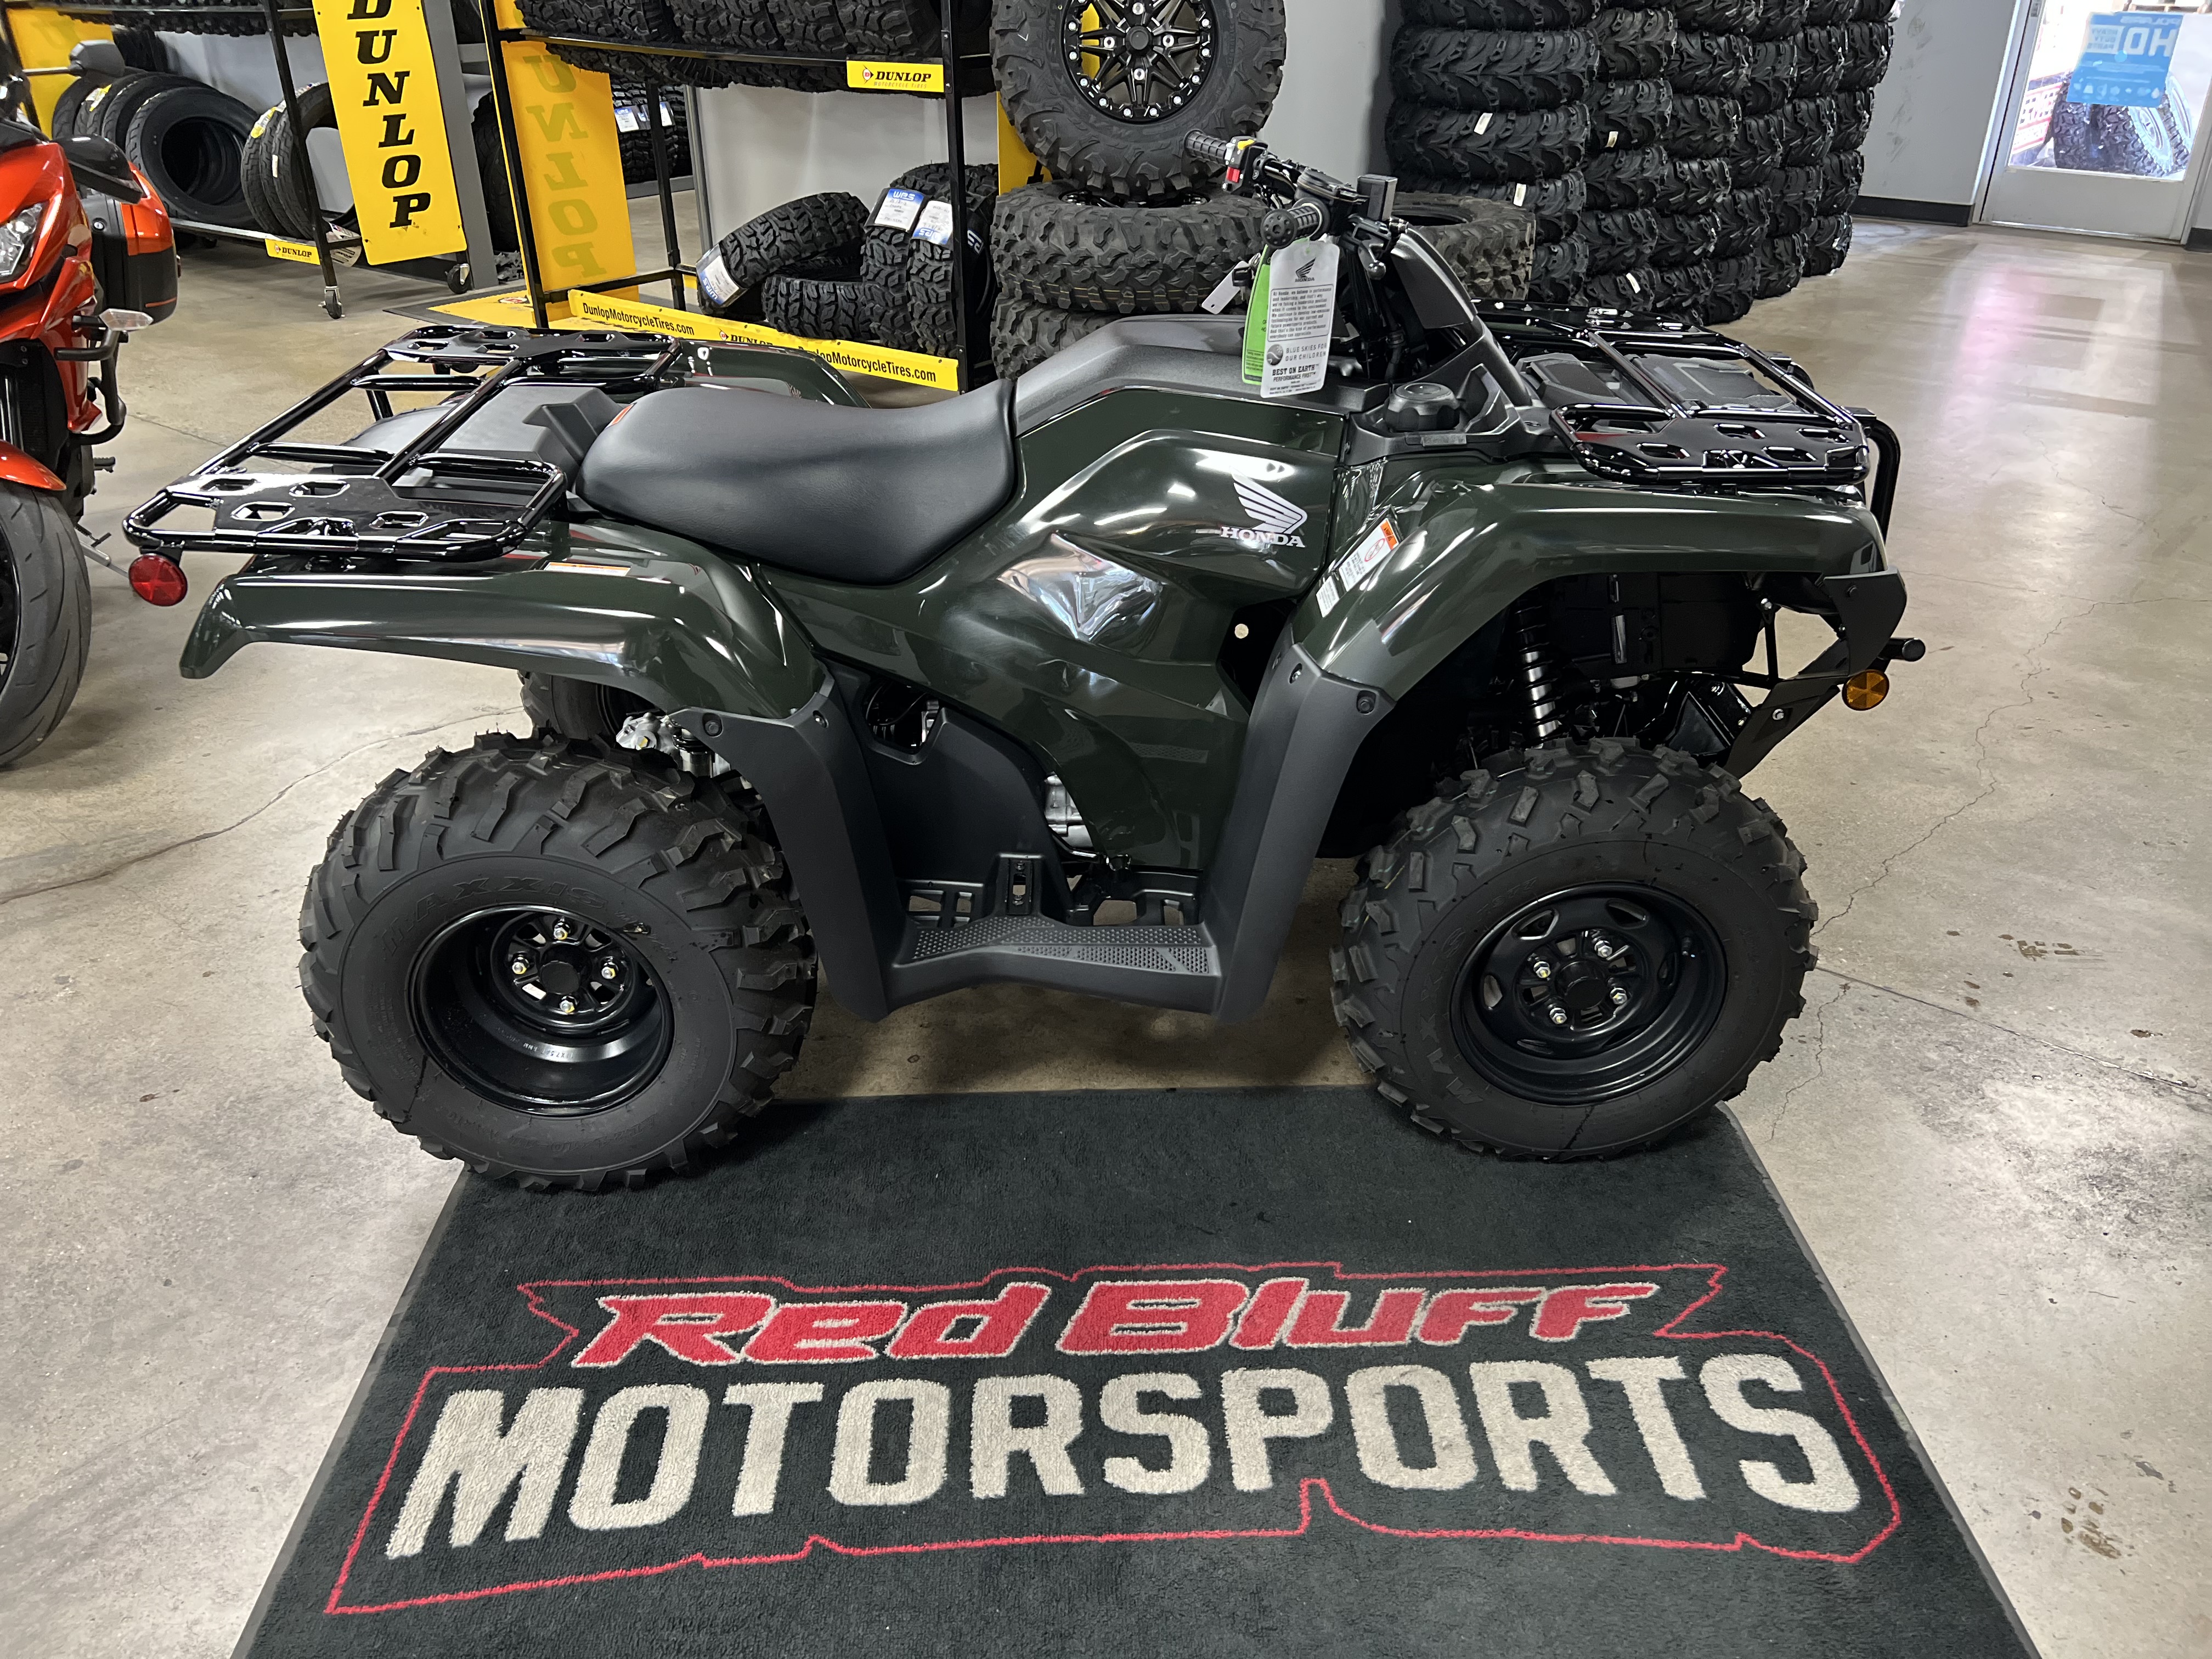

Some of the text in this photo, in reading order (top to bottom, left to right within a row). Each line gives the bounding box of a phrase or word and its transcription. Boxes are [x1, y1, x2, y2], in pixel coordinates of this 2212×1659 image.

[875, 71, 932, 82] DUNLOP
[347, 0, 431, 228] DUNLOP
[893, 190, 916, 201] WPS
[282, 247, 312, 257] DUNLOP
[583, 303, 695, 336] DunlopMotorcycleTires.com
[1299, 351, 1327, 360] CHILDREN
[1220, 525, 1306, 548] HONDA
[380, 876, 610, 956] MAXXIS
[571, 1277, 1661, 1369] Red Bluff
[385, 1353, 1861, 1560] MOTORSPORTS
